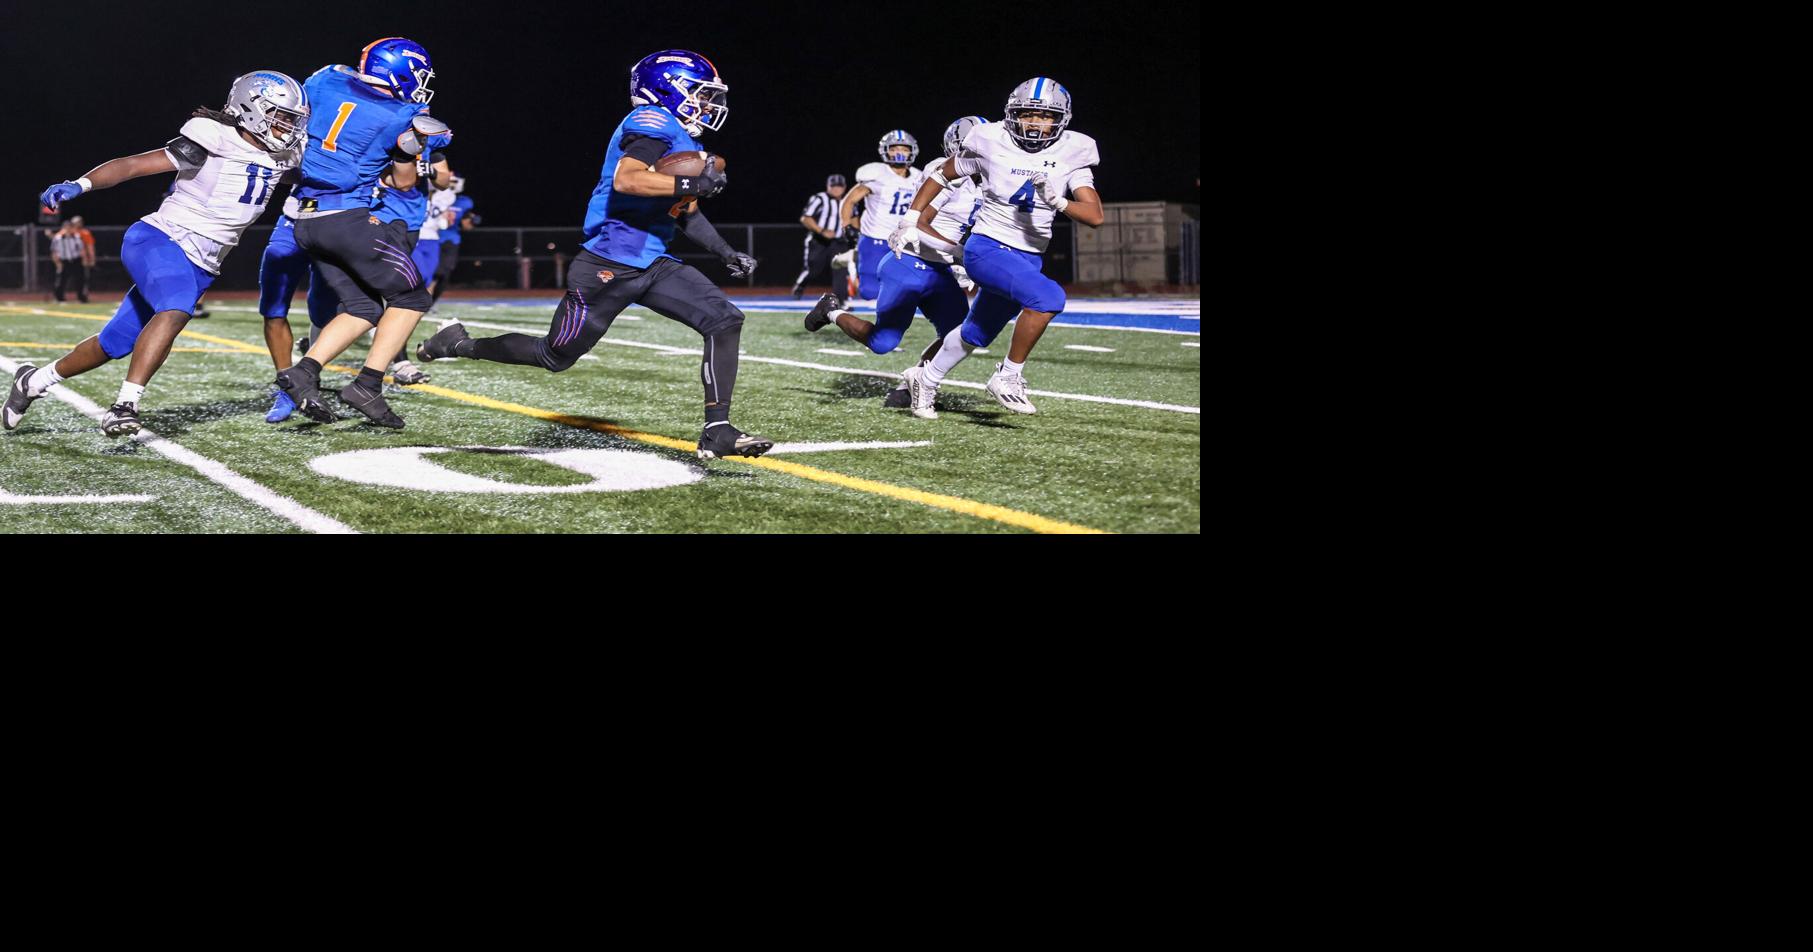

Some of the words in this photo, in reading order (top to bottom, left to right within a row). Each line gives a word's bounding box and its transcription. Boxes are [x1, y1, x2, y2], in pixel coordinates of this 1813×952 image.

[321, 101, 357, 153] 1
[238, 163, 272, 205] 11
[1008, 177, 1036, 213] 4
